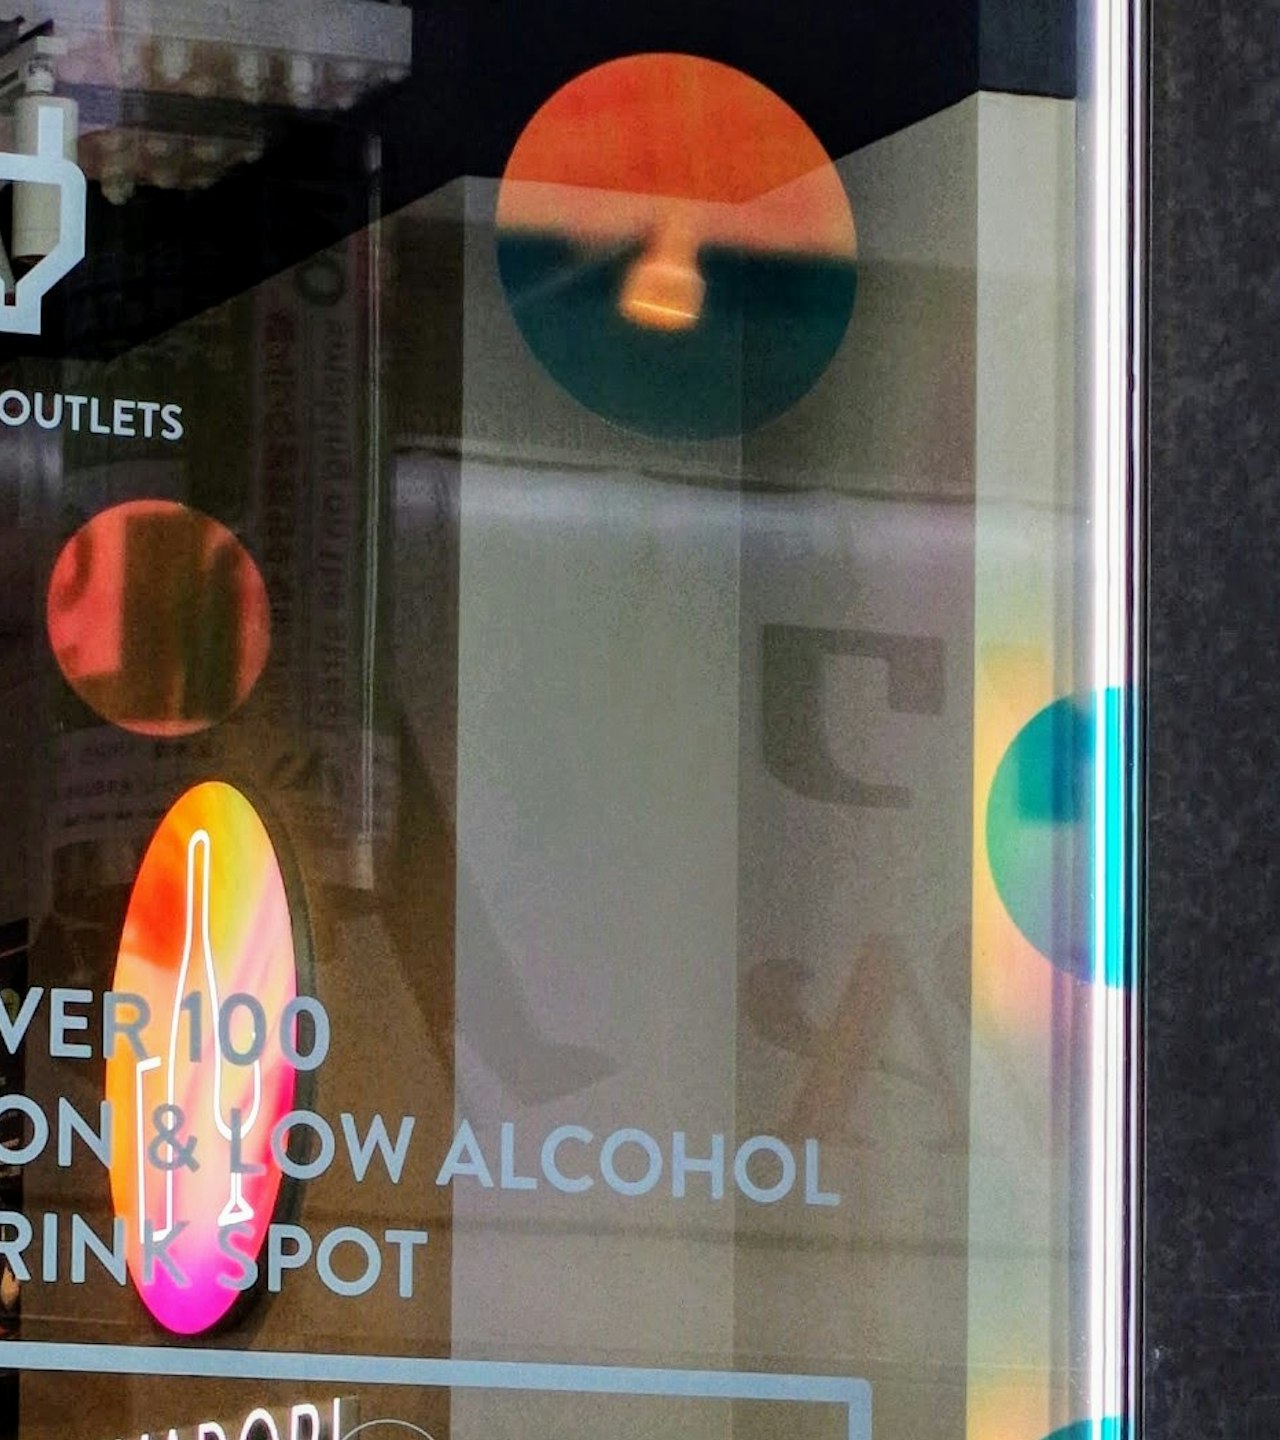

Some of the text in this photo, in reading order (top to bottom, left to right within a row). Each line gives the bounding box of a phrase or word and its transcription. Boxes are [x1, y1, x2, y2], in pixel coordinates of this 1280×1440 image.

[182, 992, 332, 1070] 100
[145, 1103, 201, 1173] &
[229, 1112, 413, 1185] LOW
[434, 1123, 841, 1207] ALCOHOL
[217, 1224, 429, 1299] SPOT
